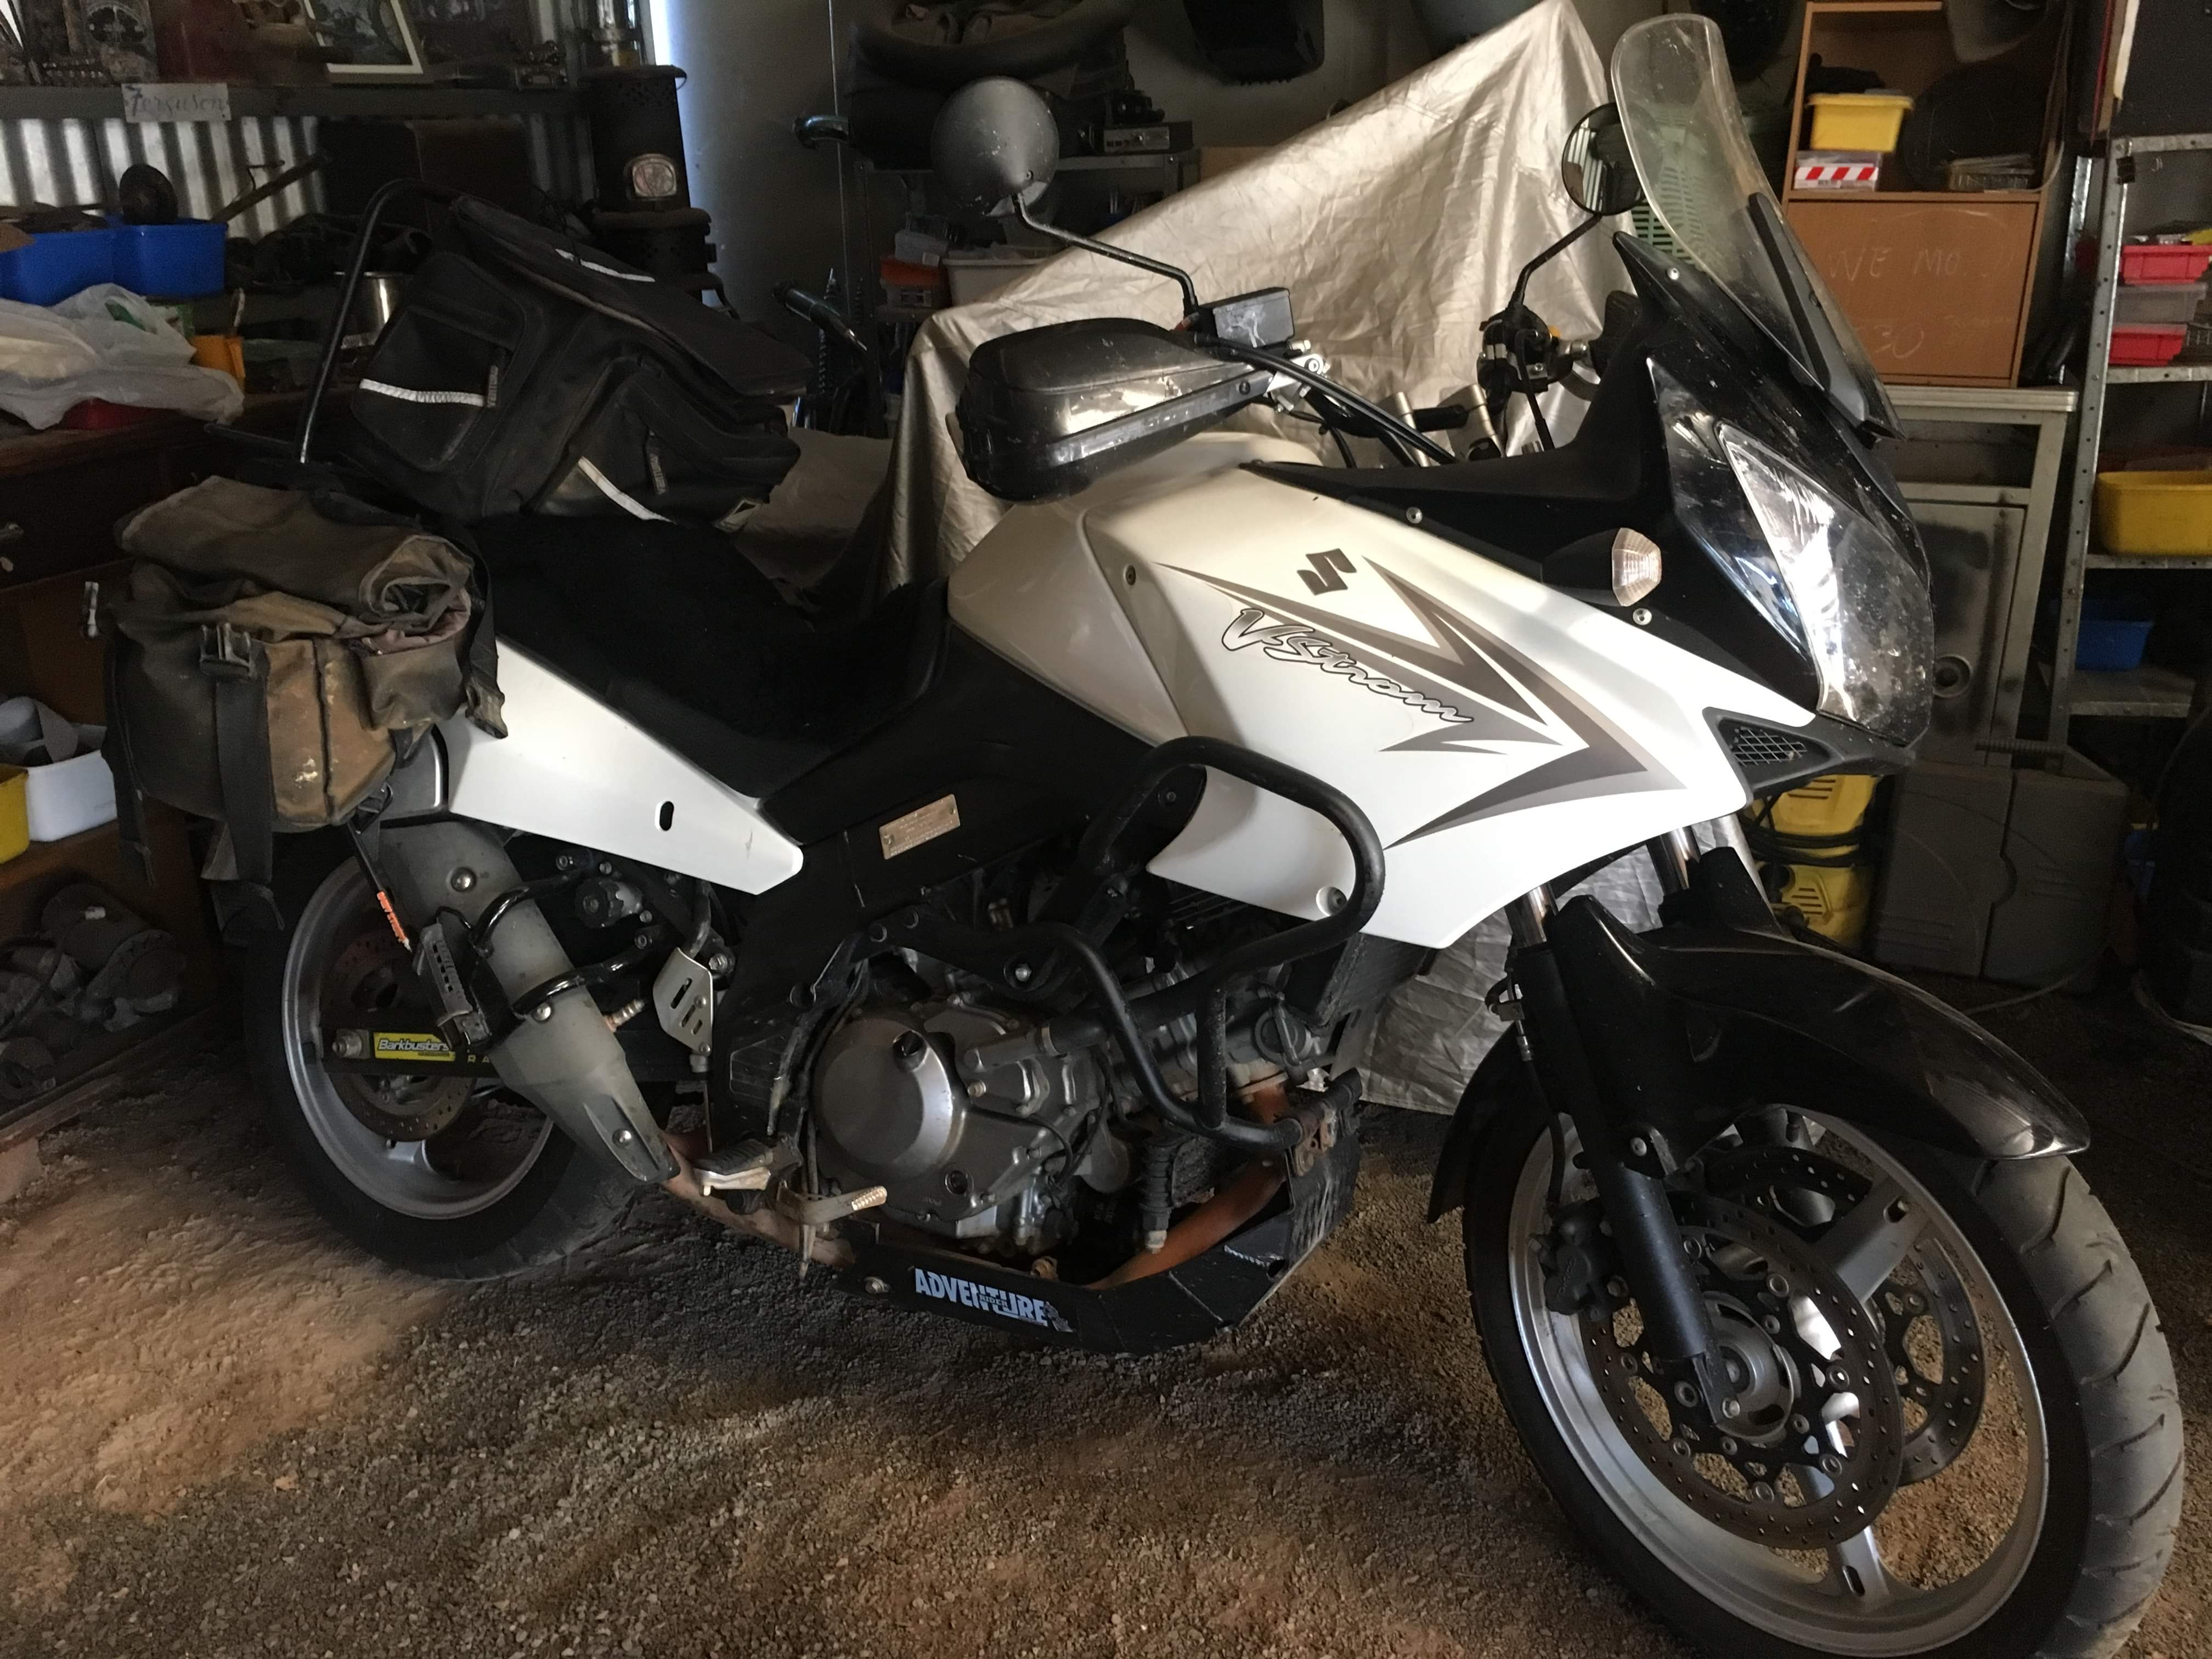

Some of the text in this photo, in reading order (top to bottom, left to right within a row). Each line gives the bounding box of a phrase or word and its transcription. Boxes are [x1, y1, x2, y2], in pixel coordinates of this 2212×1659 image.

[377, 1038, 450, 1052] Barkbusters
[915, 1268, 1048, 1327] ADVENTURE
[979, 1294, 1008, 1308] RIDER
